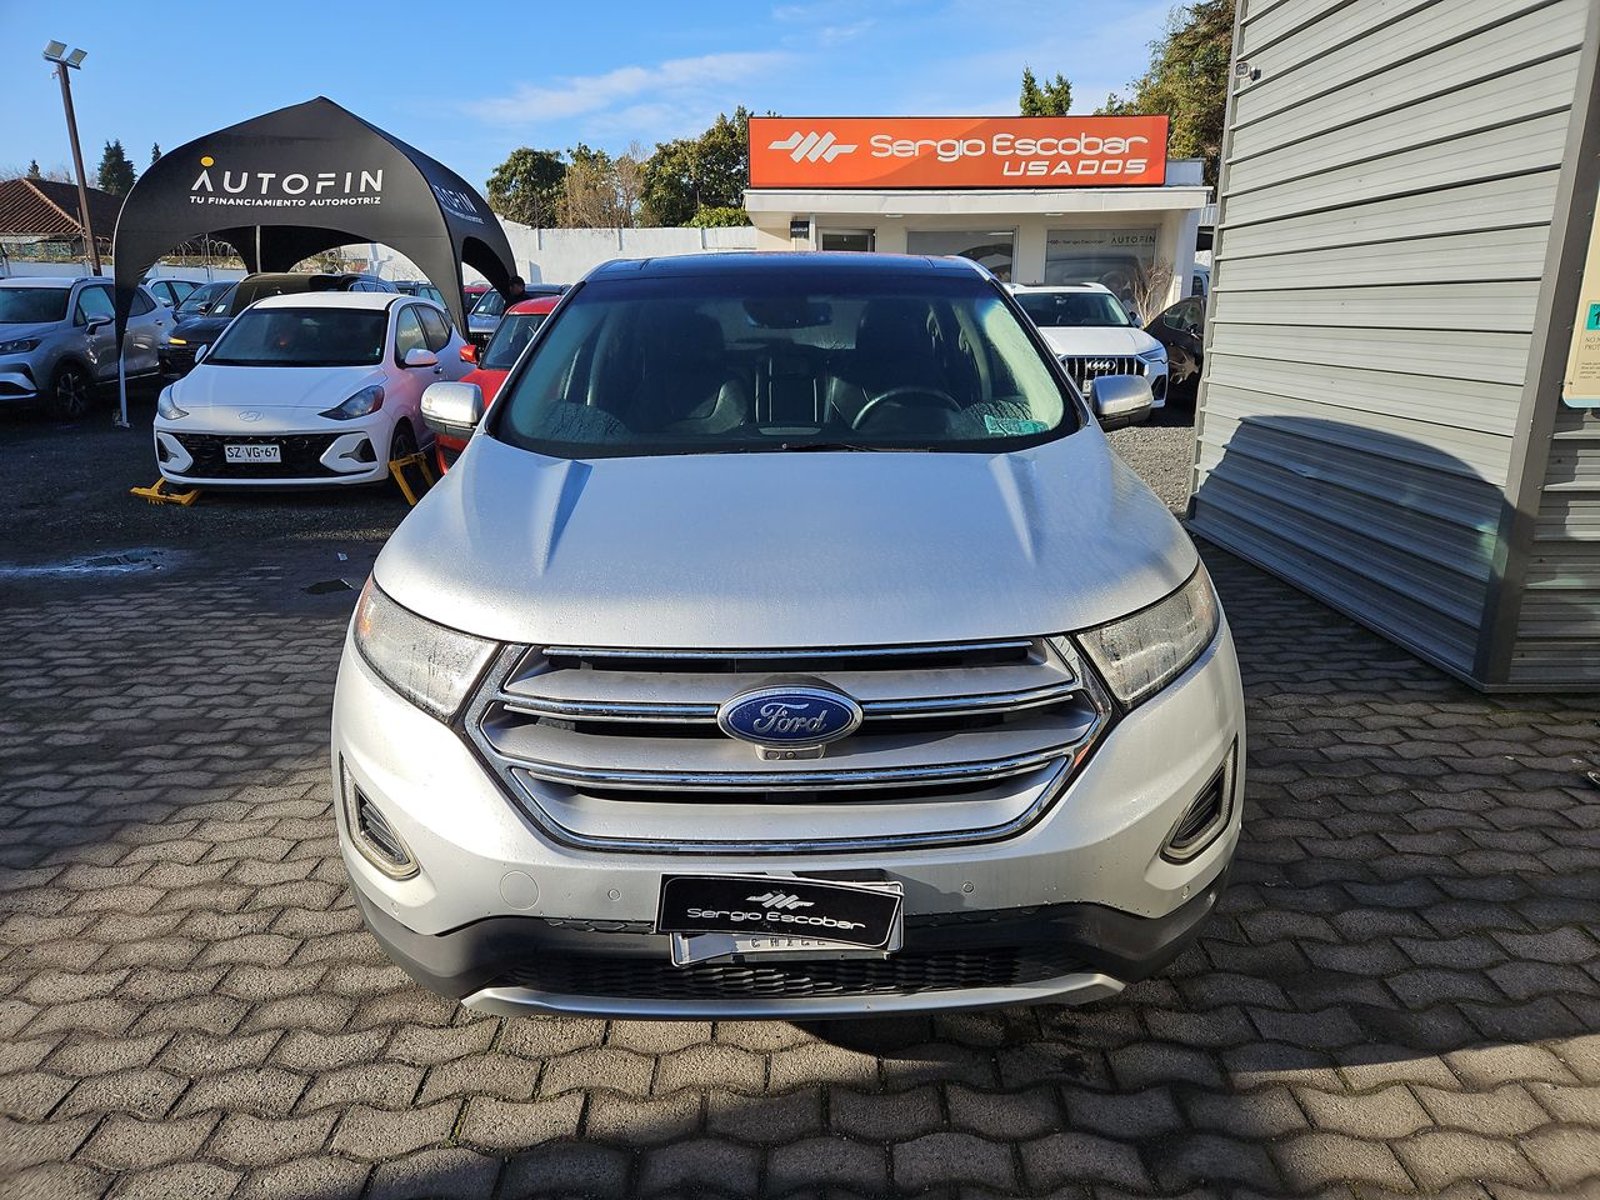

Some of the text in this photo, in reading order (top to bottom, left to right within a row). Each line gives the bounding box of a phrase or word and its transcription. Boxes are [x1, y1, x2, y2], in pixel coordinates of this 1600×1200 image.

[870, 132, 1148, 161] Sergio Escobar
[1002, 159, 1148, 176] USADOS
[190, 168, 384, 196] AUTOFIN
[189, 195, 382, 208] TU FINANCIAMIENTO AUTOMOTRIZ
[1111, 235, 1155, 244] AUTOFIN
[753, 702, 828, 733] Ford
[687, 908, 867, 930] Sergio Escobar
